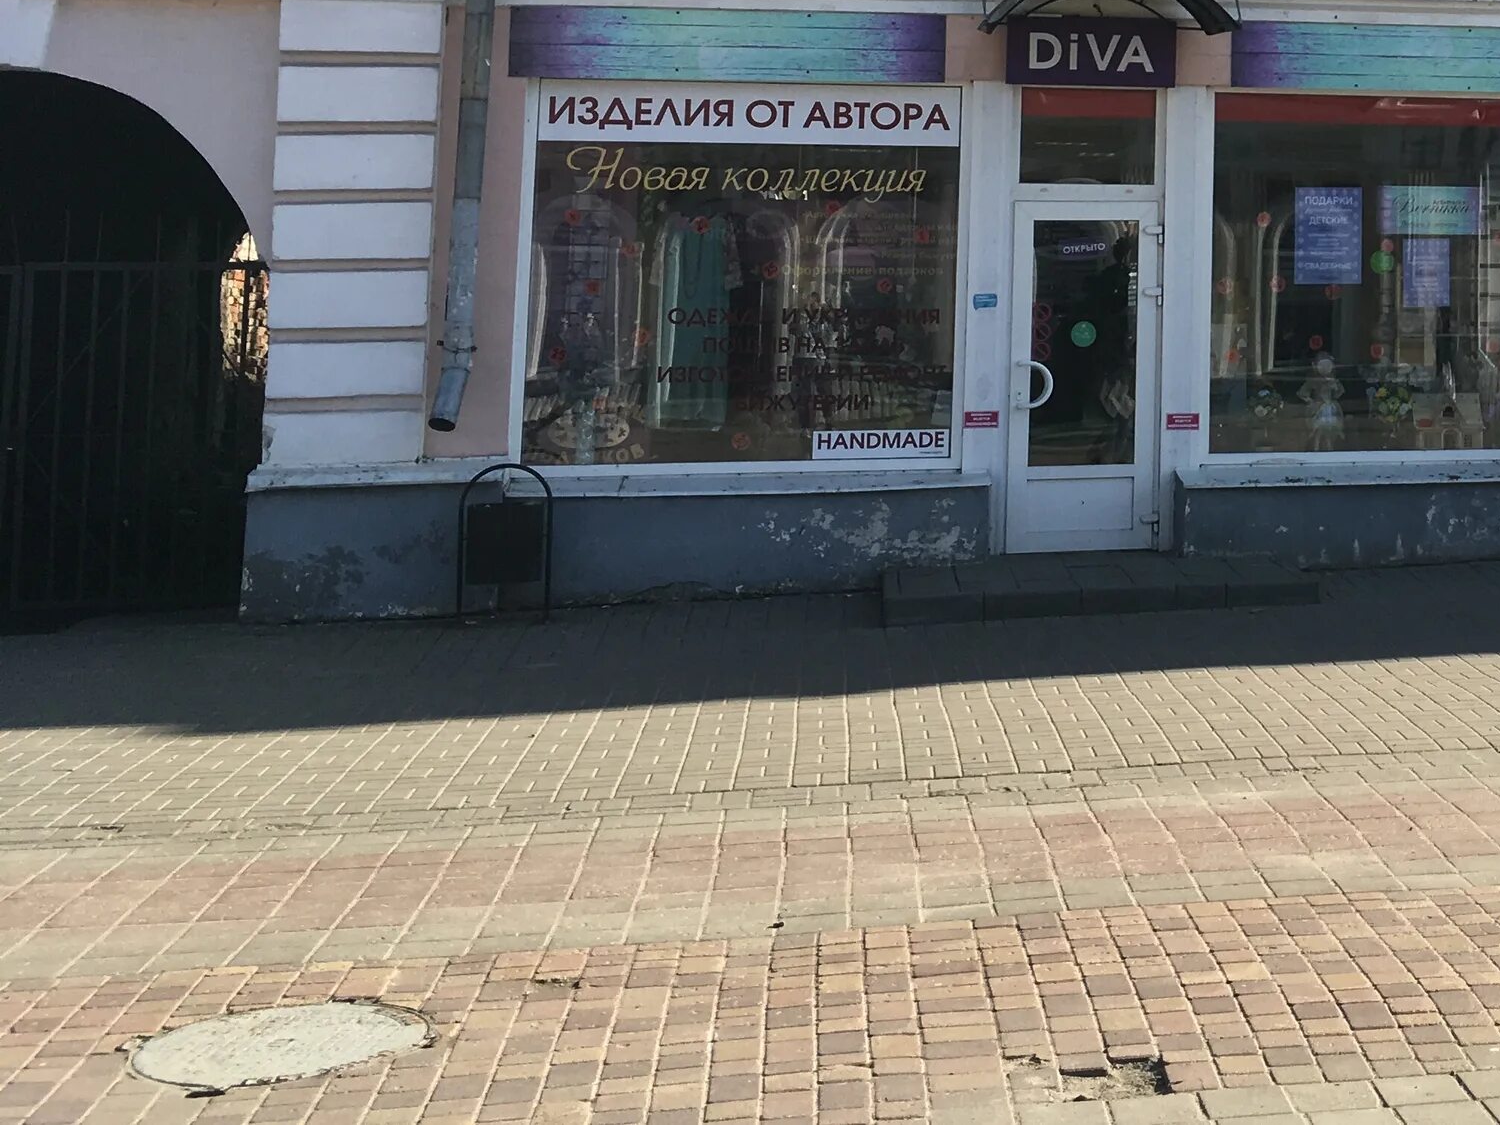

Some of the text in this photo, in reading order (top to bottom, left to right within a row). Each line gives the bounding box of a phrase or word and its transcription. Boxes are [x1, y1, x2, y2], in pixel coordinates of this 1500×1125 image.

[1028, 32, 1155, 73] DiVA
[548, 96, 951, 131] ИЗДЕЛИЯ ОТ АВТОРА
[566, 146, 927, 204] Новая коллекция
[1304, 196, 1353, 206] ПОДАРКИ
[1062, 242, 1106, 254] ОТКРЫТО
[668, 307, 772, 327] ОДЕЖ
[817, 431, 945, 450] HANDMADE
